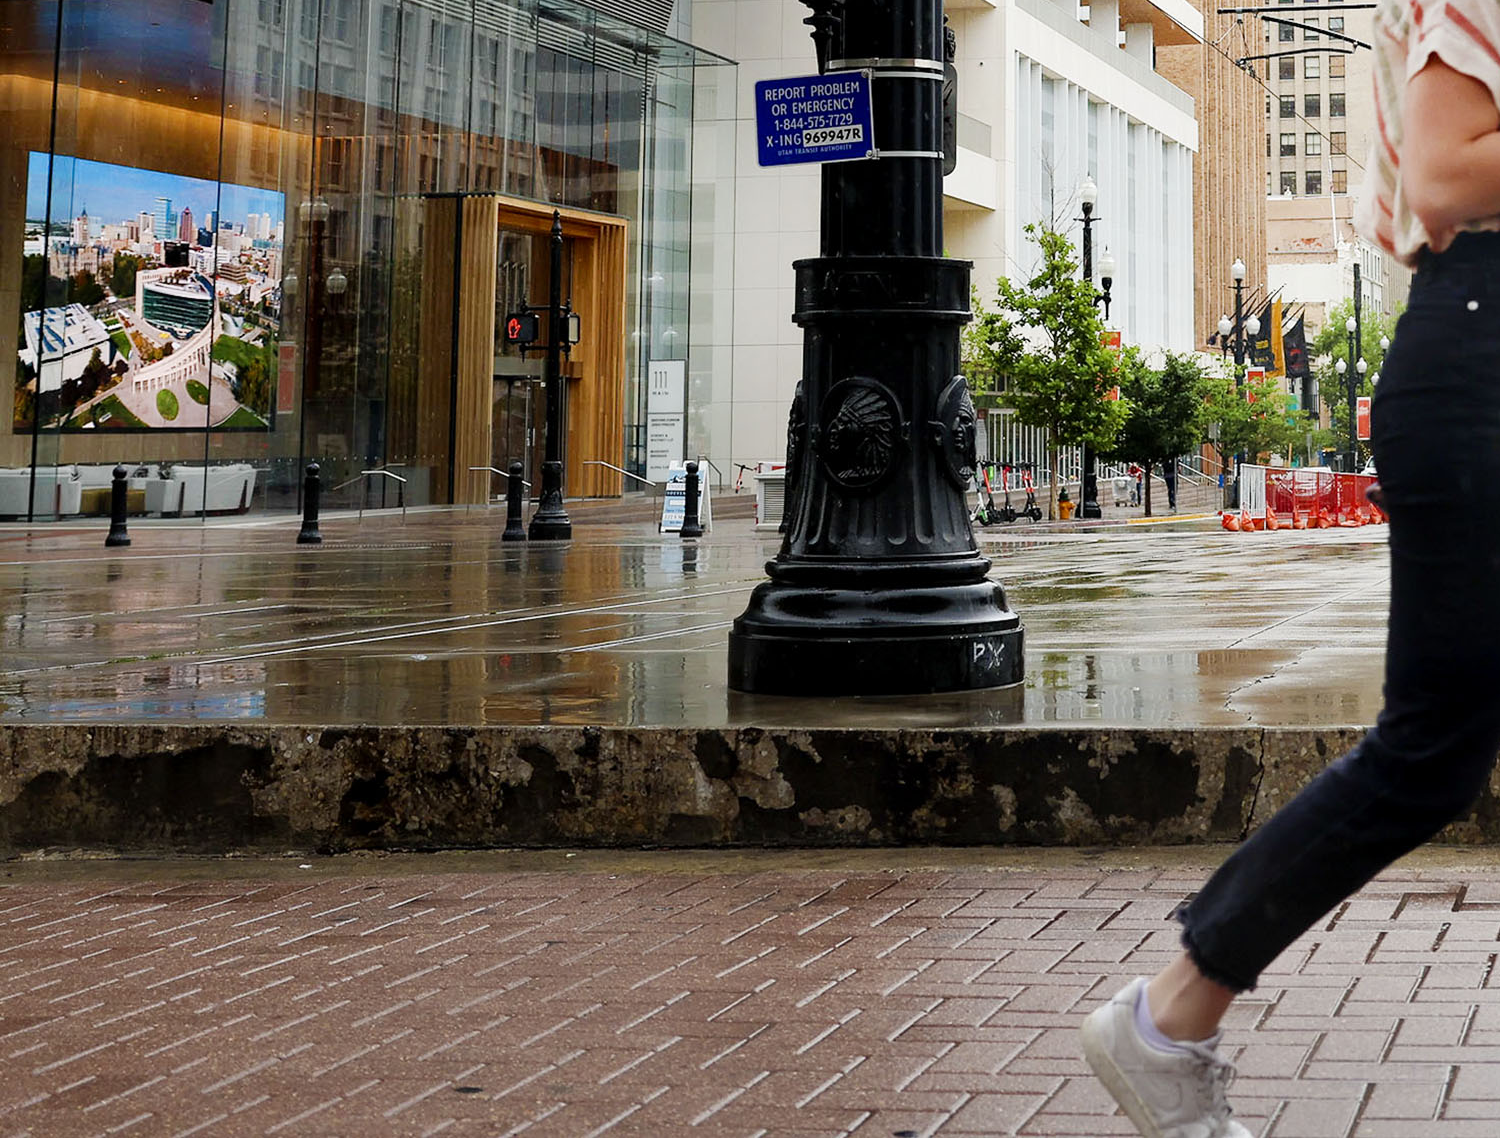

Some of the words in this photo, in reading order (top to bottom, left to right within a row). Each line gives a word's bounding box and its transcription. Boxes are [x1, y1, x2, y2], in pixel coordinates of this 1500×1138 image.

[765, 86, 806, 101] REPORT
[810, 81, 860, 97] PROBLEM
[771, 103, 788, 117] OR
[792, 97, 855, 114] EMERGENCY
[774, 113, 853, 131] 1-844-575-7729
[766, 133, 802, 148] X-ING
[804, 128, 862, 144] 969947R
[778, 148, 793, 156] UTAH
[795, 147, 818, 155] TRANSIT
[820, 144, 852, 152] AUTHORITY
[654, 371, 668, 389] 111
